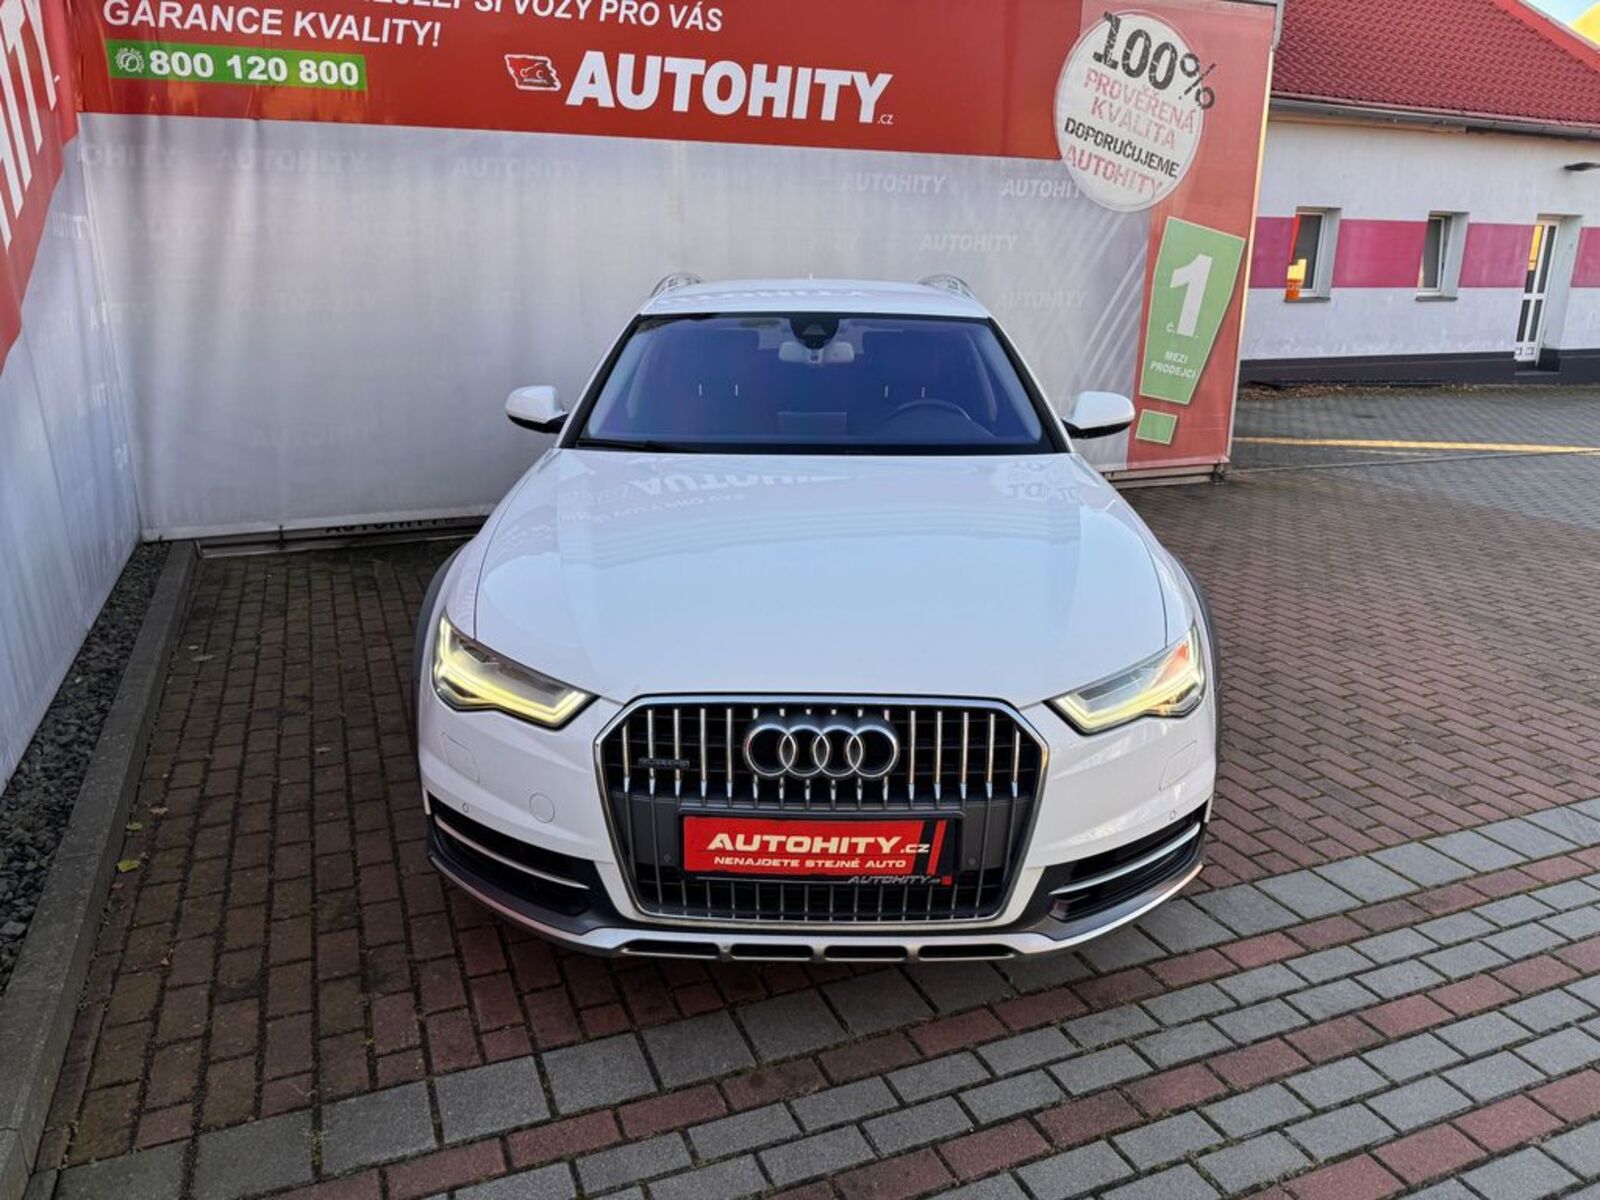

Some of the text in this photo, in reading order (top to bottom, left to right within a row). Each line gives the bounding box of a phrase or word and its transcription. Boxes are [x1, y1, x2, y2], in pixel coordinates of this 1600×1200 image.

[103, 0, 441, 47] GARANCE KVALITY!
[514, 0, 592, 20] VOZY
[599, 0, 660, 26] PRO
[669, 0, 723, 32] VÁS
[149, 49, 214, 78] 800
[226, 54, 288, 82] 120
[299, 59, 359, 86] 800
[1093, 11, 1216, 110] 100%
[1084, 68, 1197, 134] PROVĚŘENÁ
[1091, 96, 1176, 150] KVALITA
[1064, 117, 1180, 179] DOPORUČUJEME
[841, 172, 947, 195] AUTOHITY
[1066, 144, 1162, 198] AUTOHITY
[919, 233, 1018, 252] AUTOHITY
[1150, 360, 1197, 379] PRODEJCI
[1164, 350, 1188, 364] MEZI
[714, 856, 906, 869] NENAJDETE STEJNÉ AUTO
